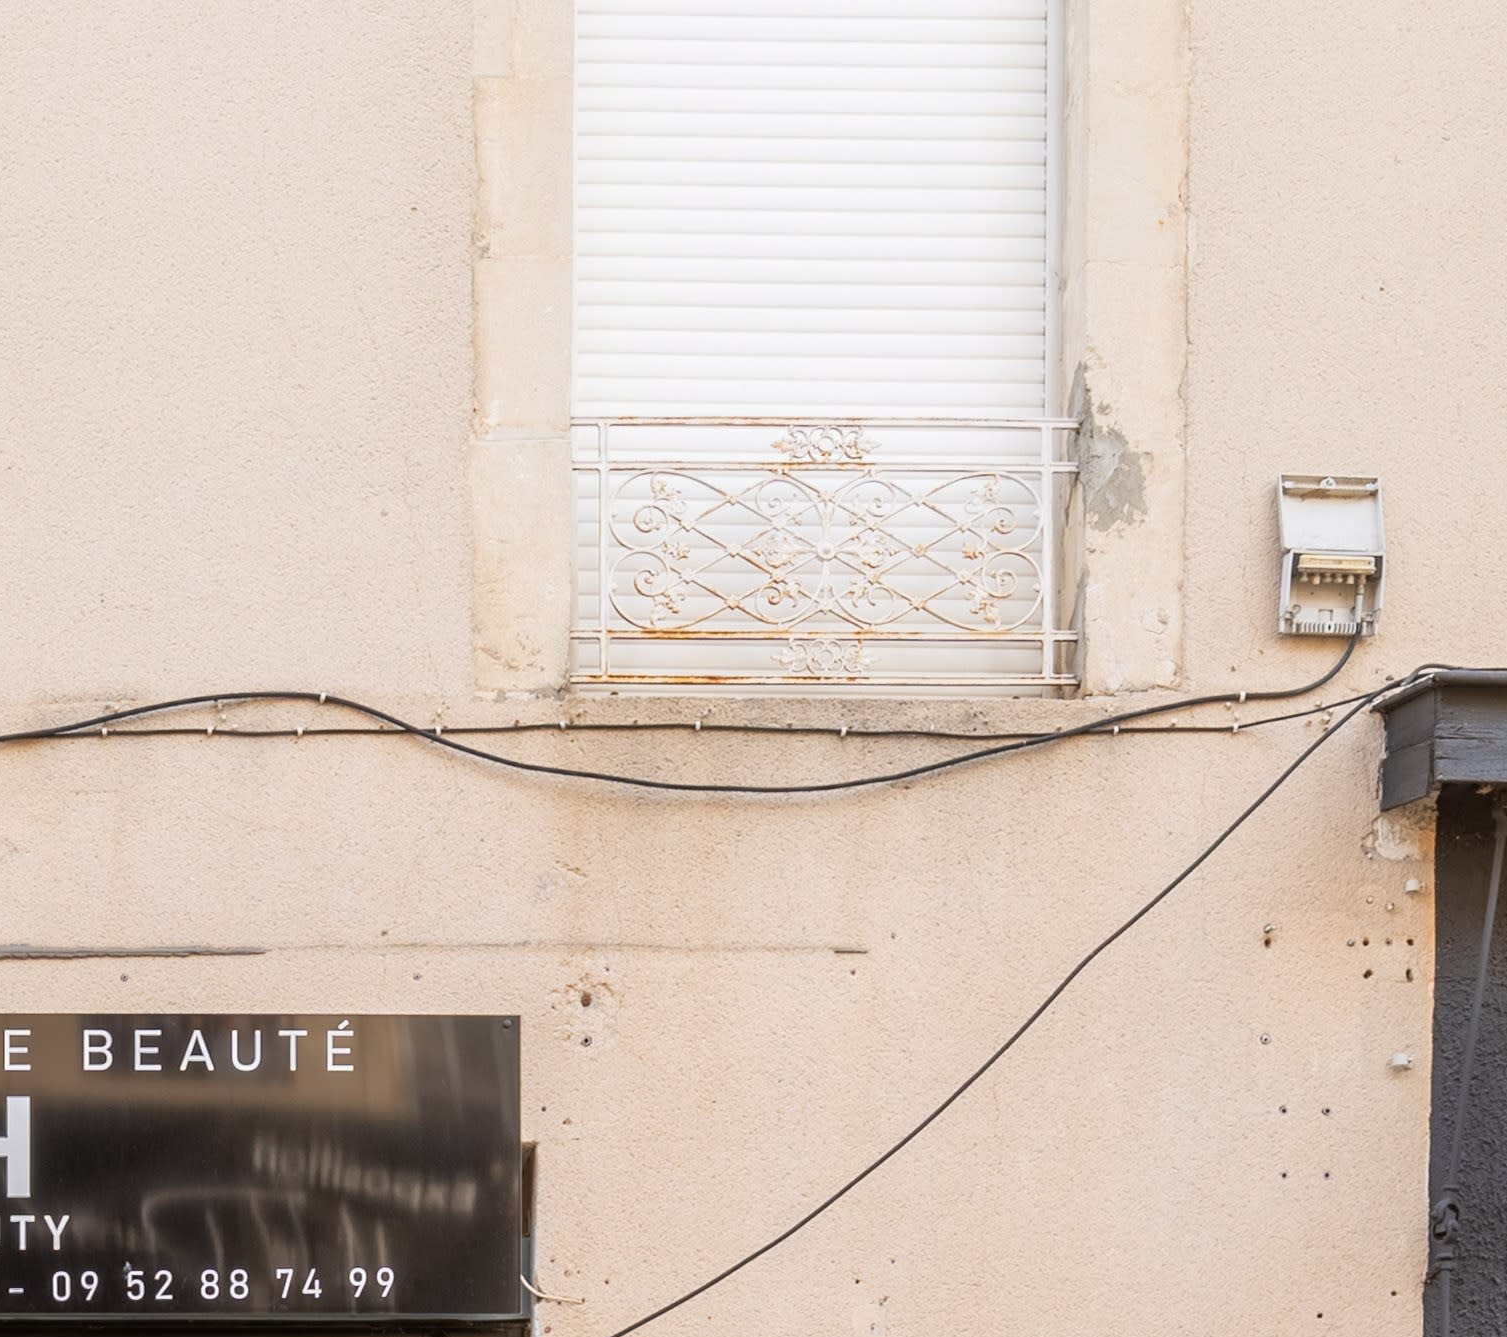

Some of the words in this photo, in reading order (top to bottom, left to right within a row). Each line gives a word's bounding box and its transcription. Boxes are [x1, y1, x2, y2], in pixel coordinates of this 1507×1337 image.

[82, 1019, 355, 1072] BEAUTÉ
[51, 1270, 100, 1302] 09
[125, 1269, 175, 1301] 52
[199, 1268, 250, 1301] 88
[275, 1268, 324, 1300] 74
[348, 1267, 396, 1299] 99
